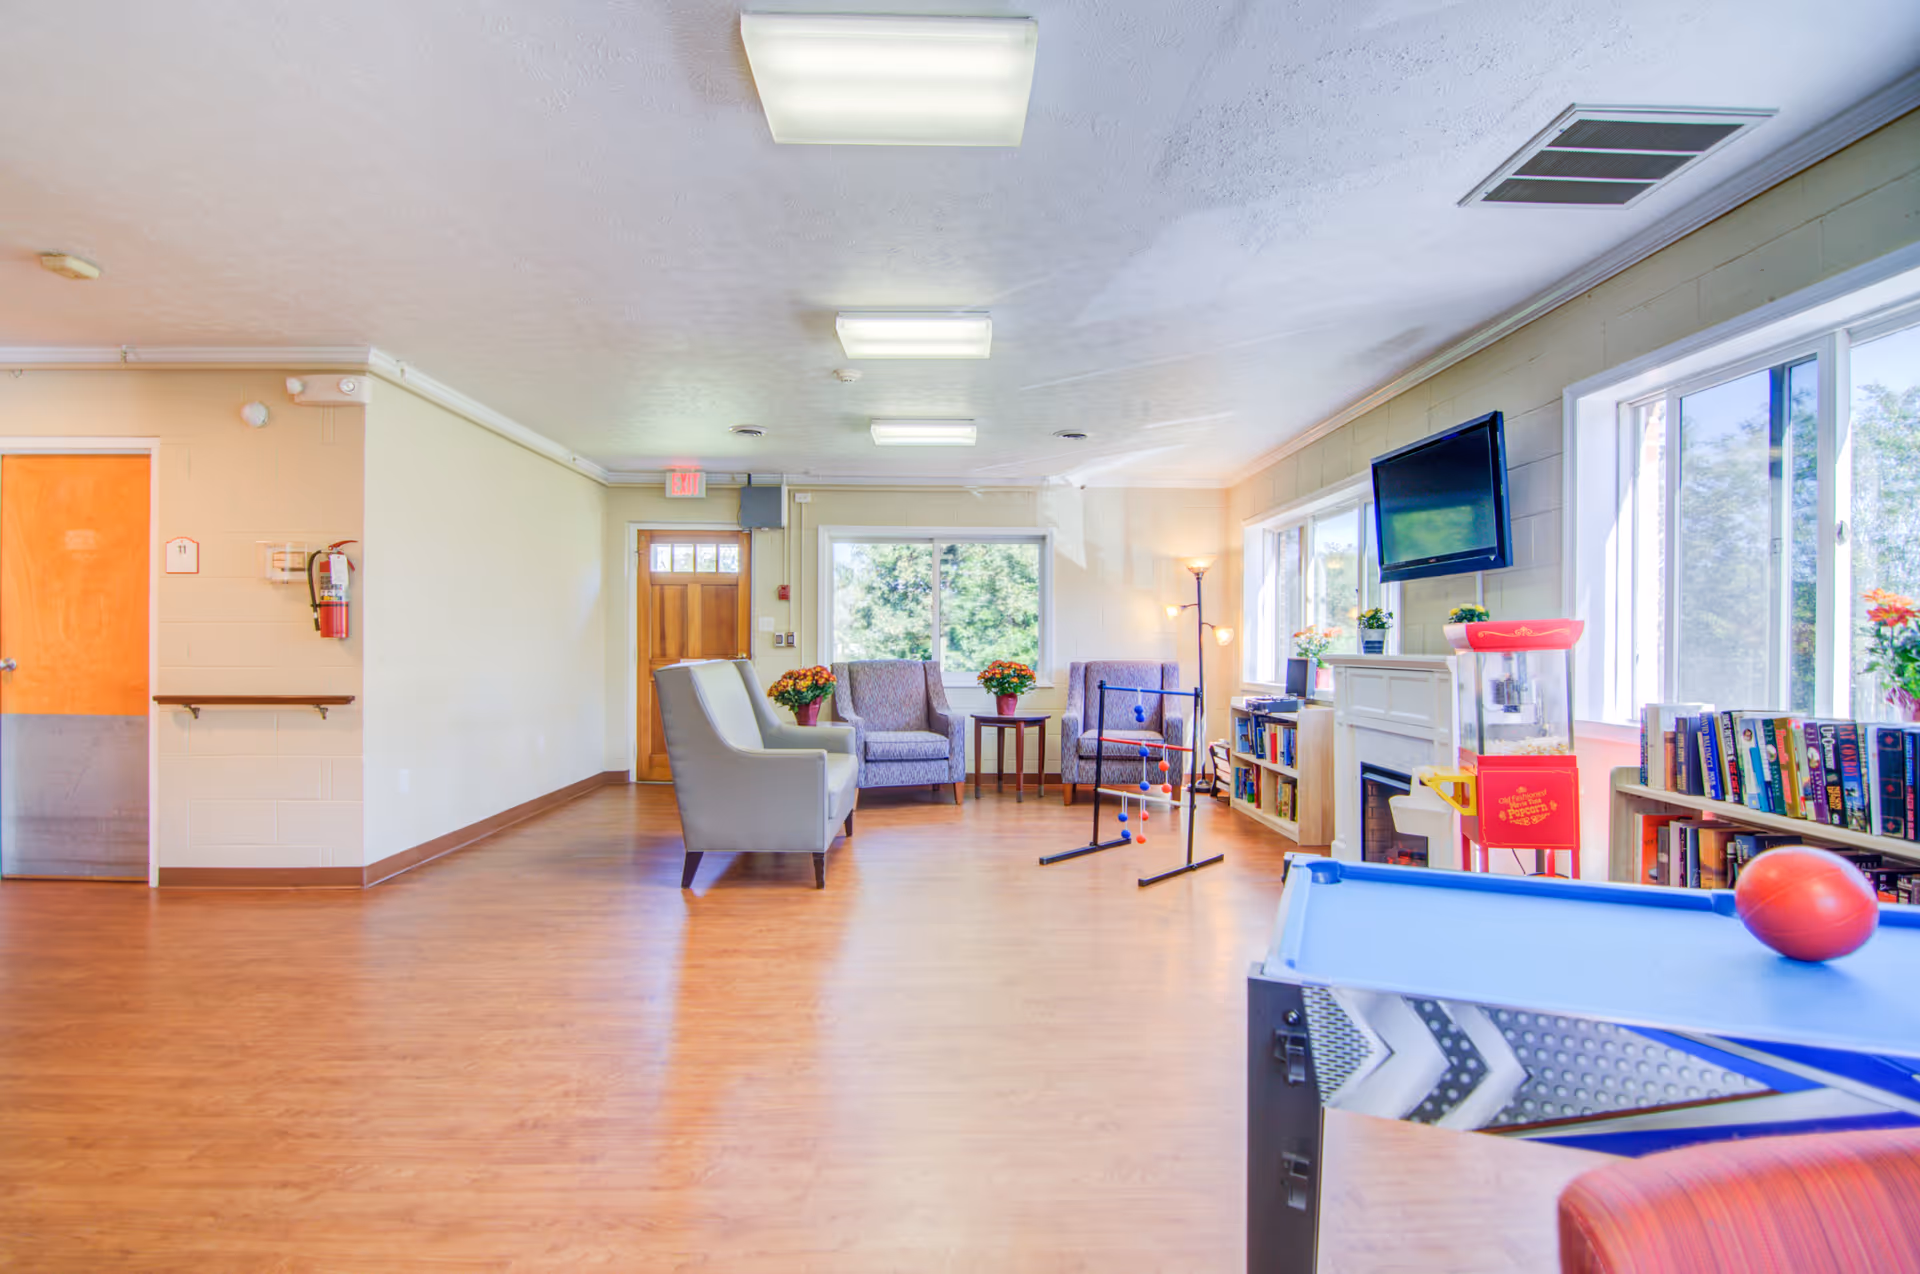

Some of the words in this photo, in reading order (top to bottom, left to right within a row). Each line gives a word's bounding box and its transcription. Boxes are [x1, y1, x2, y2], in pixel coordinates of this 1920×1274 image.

[672, 472, 699, 495] EXIT
[177, 544, 187, 554] 11
[1840, 725, 1856, 739] PAT
[1703, 735, 1713, 768] BALDACCI
[1841, 744, 1858, 777] CONROY
[1508, 803, 1549, 819] Popcorn
